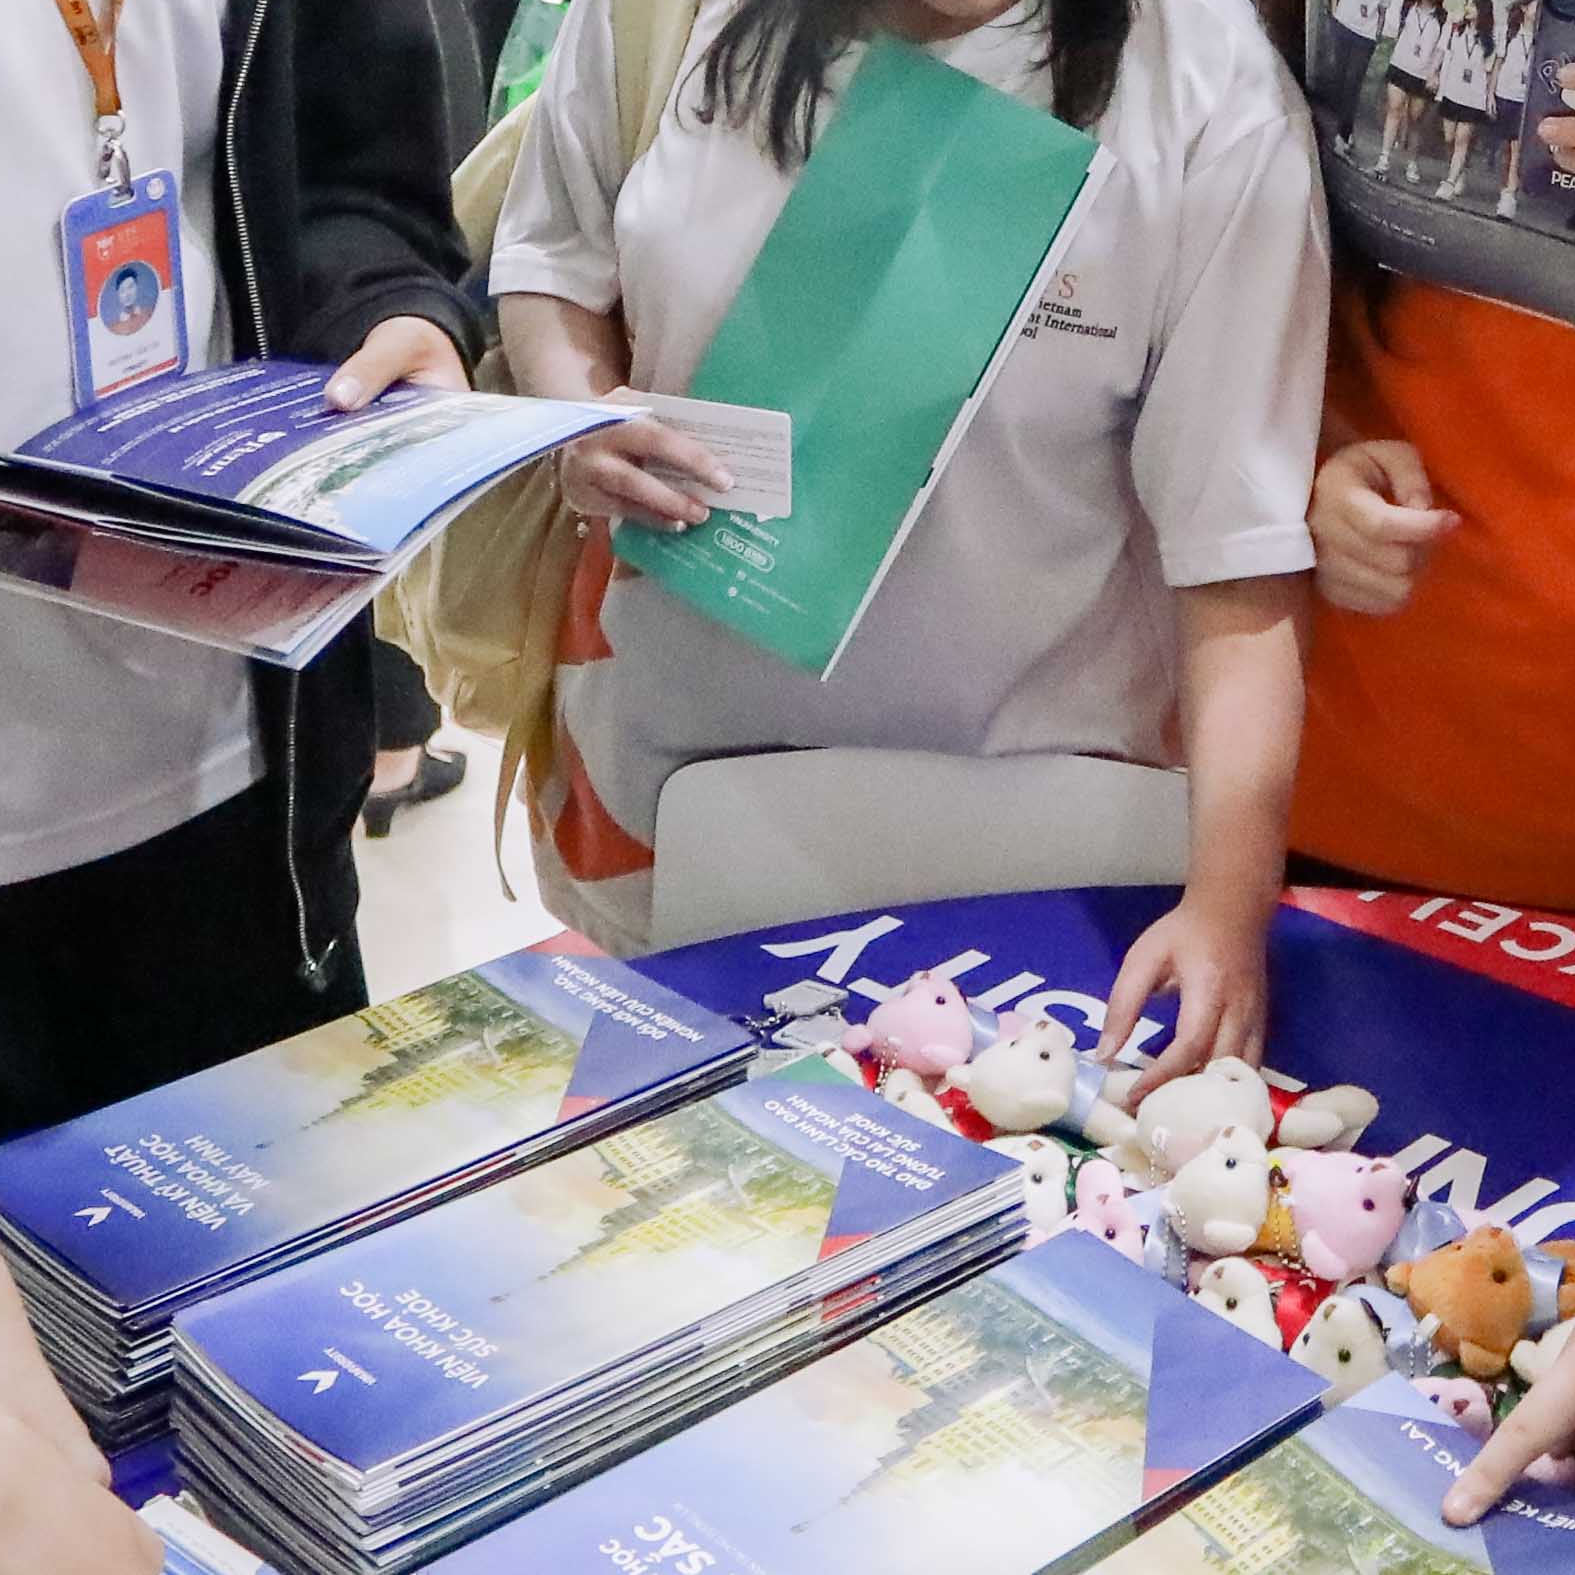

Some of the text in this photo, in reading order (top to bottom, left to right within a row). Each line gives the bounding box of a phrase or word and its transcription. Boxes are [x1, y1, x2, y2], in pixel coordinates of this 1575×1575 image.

[1038, 297, 1083, 319] ietnam
[1045, 314, 1118, 339] International
[184, 1133, 269, 1191] MÁY TÍNH
[867, 1139, 895, 1158] LAI
[104, 1144, 226, 1230] VIỆN KỸ THUẬT
[139, 1133, 253, 1216] VÀ KHOA HỌC
[339, 1280, 488, 1388] VIỆN KHOA HỌC
[448, 1327, 498, 1358] SỨC
[1399, 1420, 1436, 1452] LAI
[633, 1515, 715, 1574] SẮC
